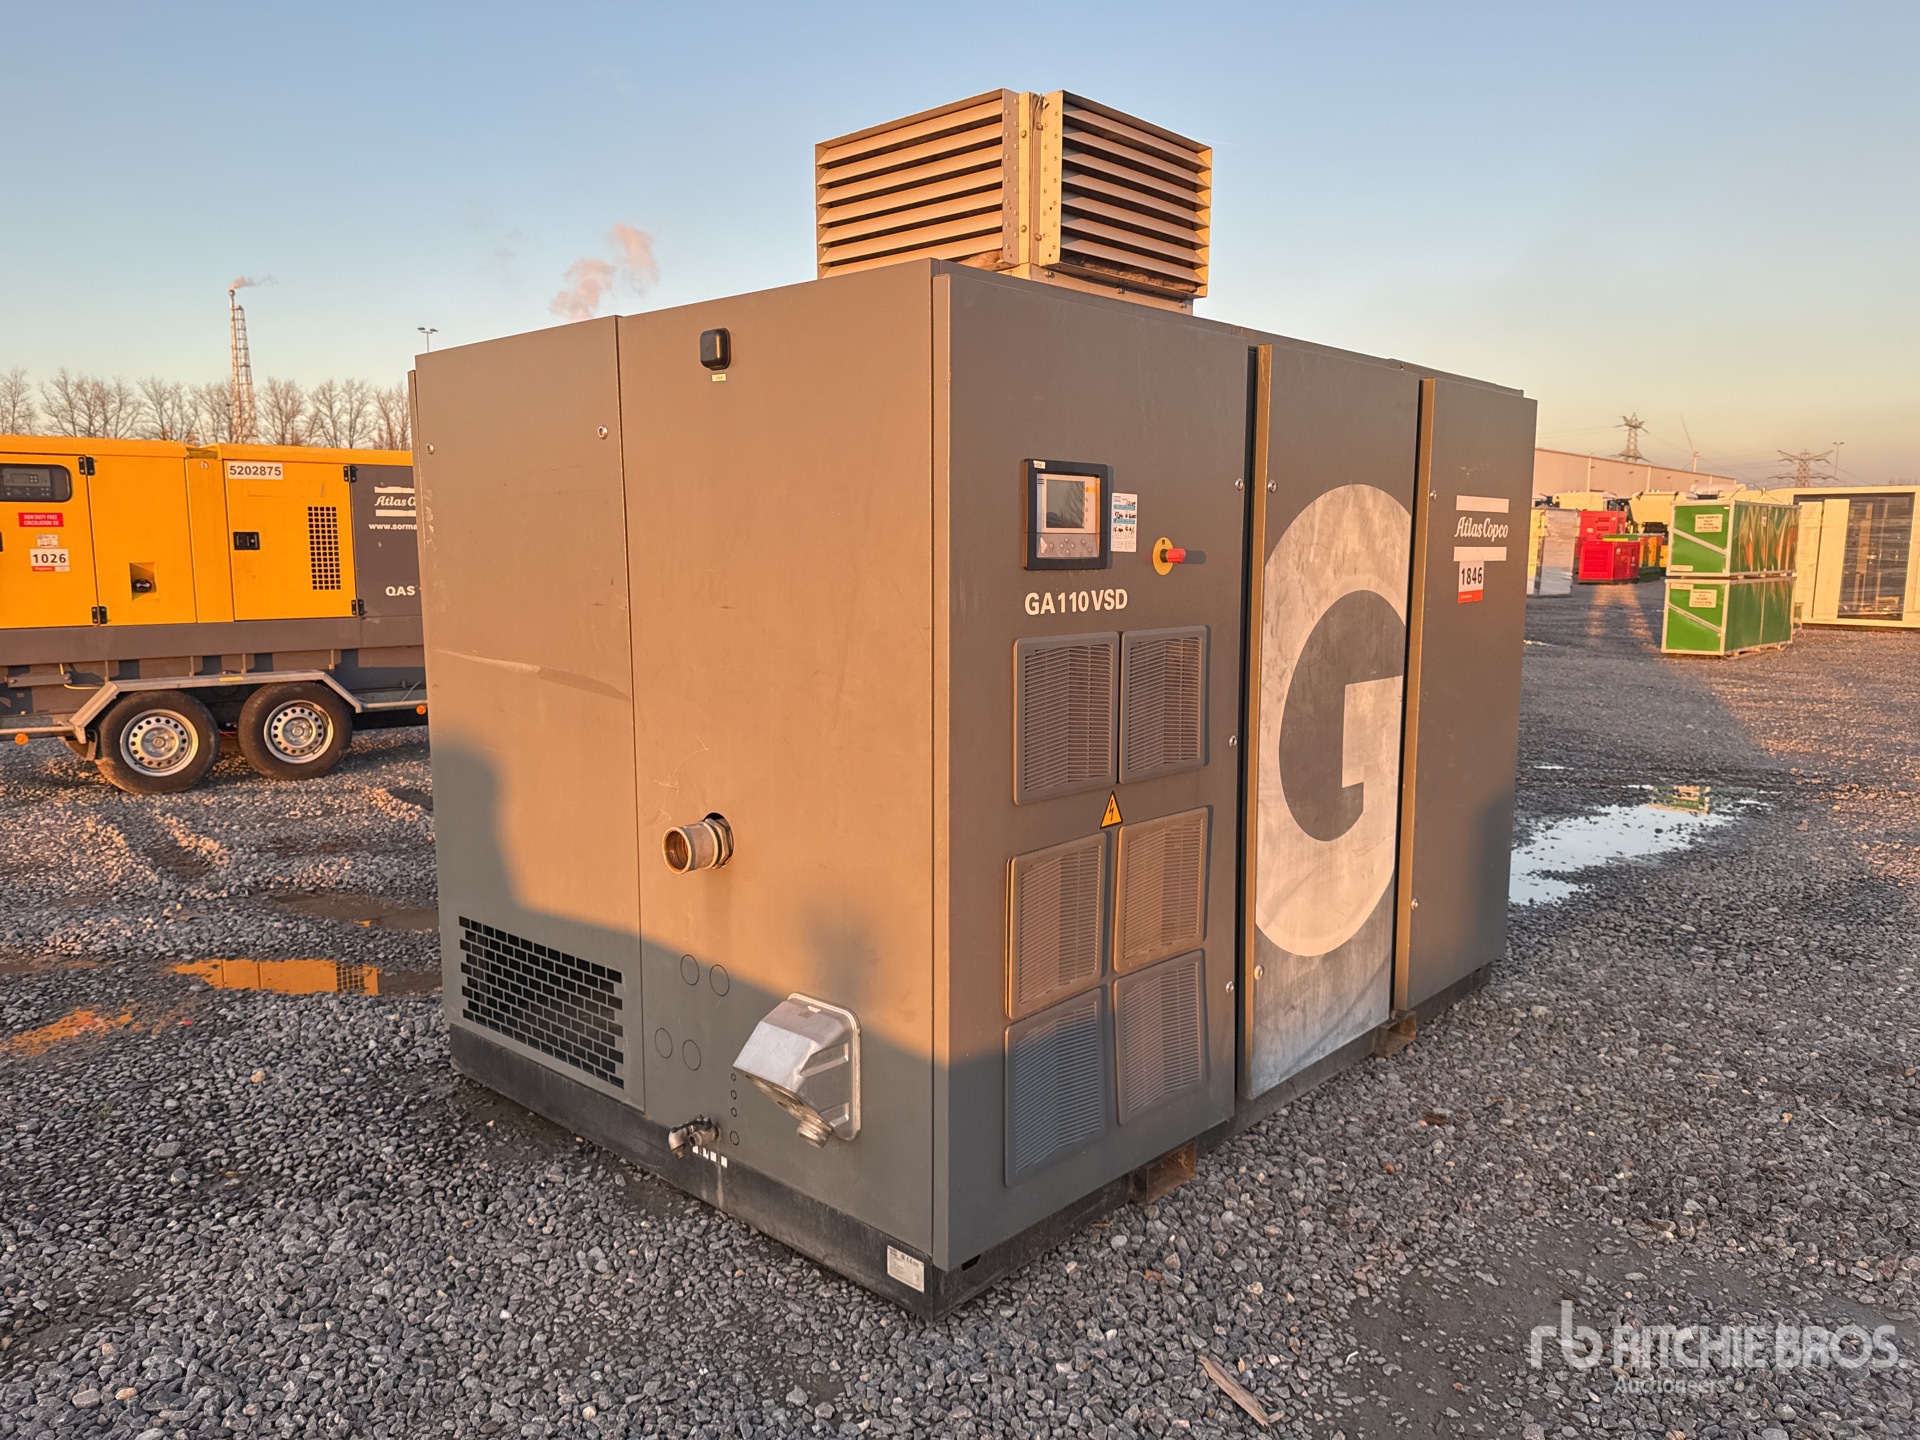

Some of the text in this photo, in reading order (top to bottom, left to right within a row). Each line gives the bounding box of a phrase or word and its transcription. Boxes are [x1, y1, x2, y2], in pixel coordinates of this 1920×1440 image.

[229, 465, 282, 477] 5202875
[374, 495, 407, 507] Atlas
[1454, 516, 1508, 542] Atlas Copco
[32, 554, 66, 563] 1026
[1461, 566, 1483, 585] 1846
[385, 586, 416, 597] QAS
